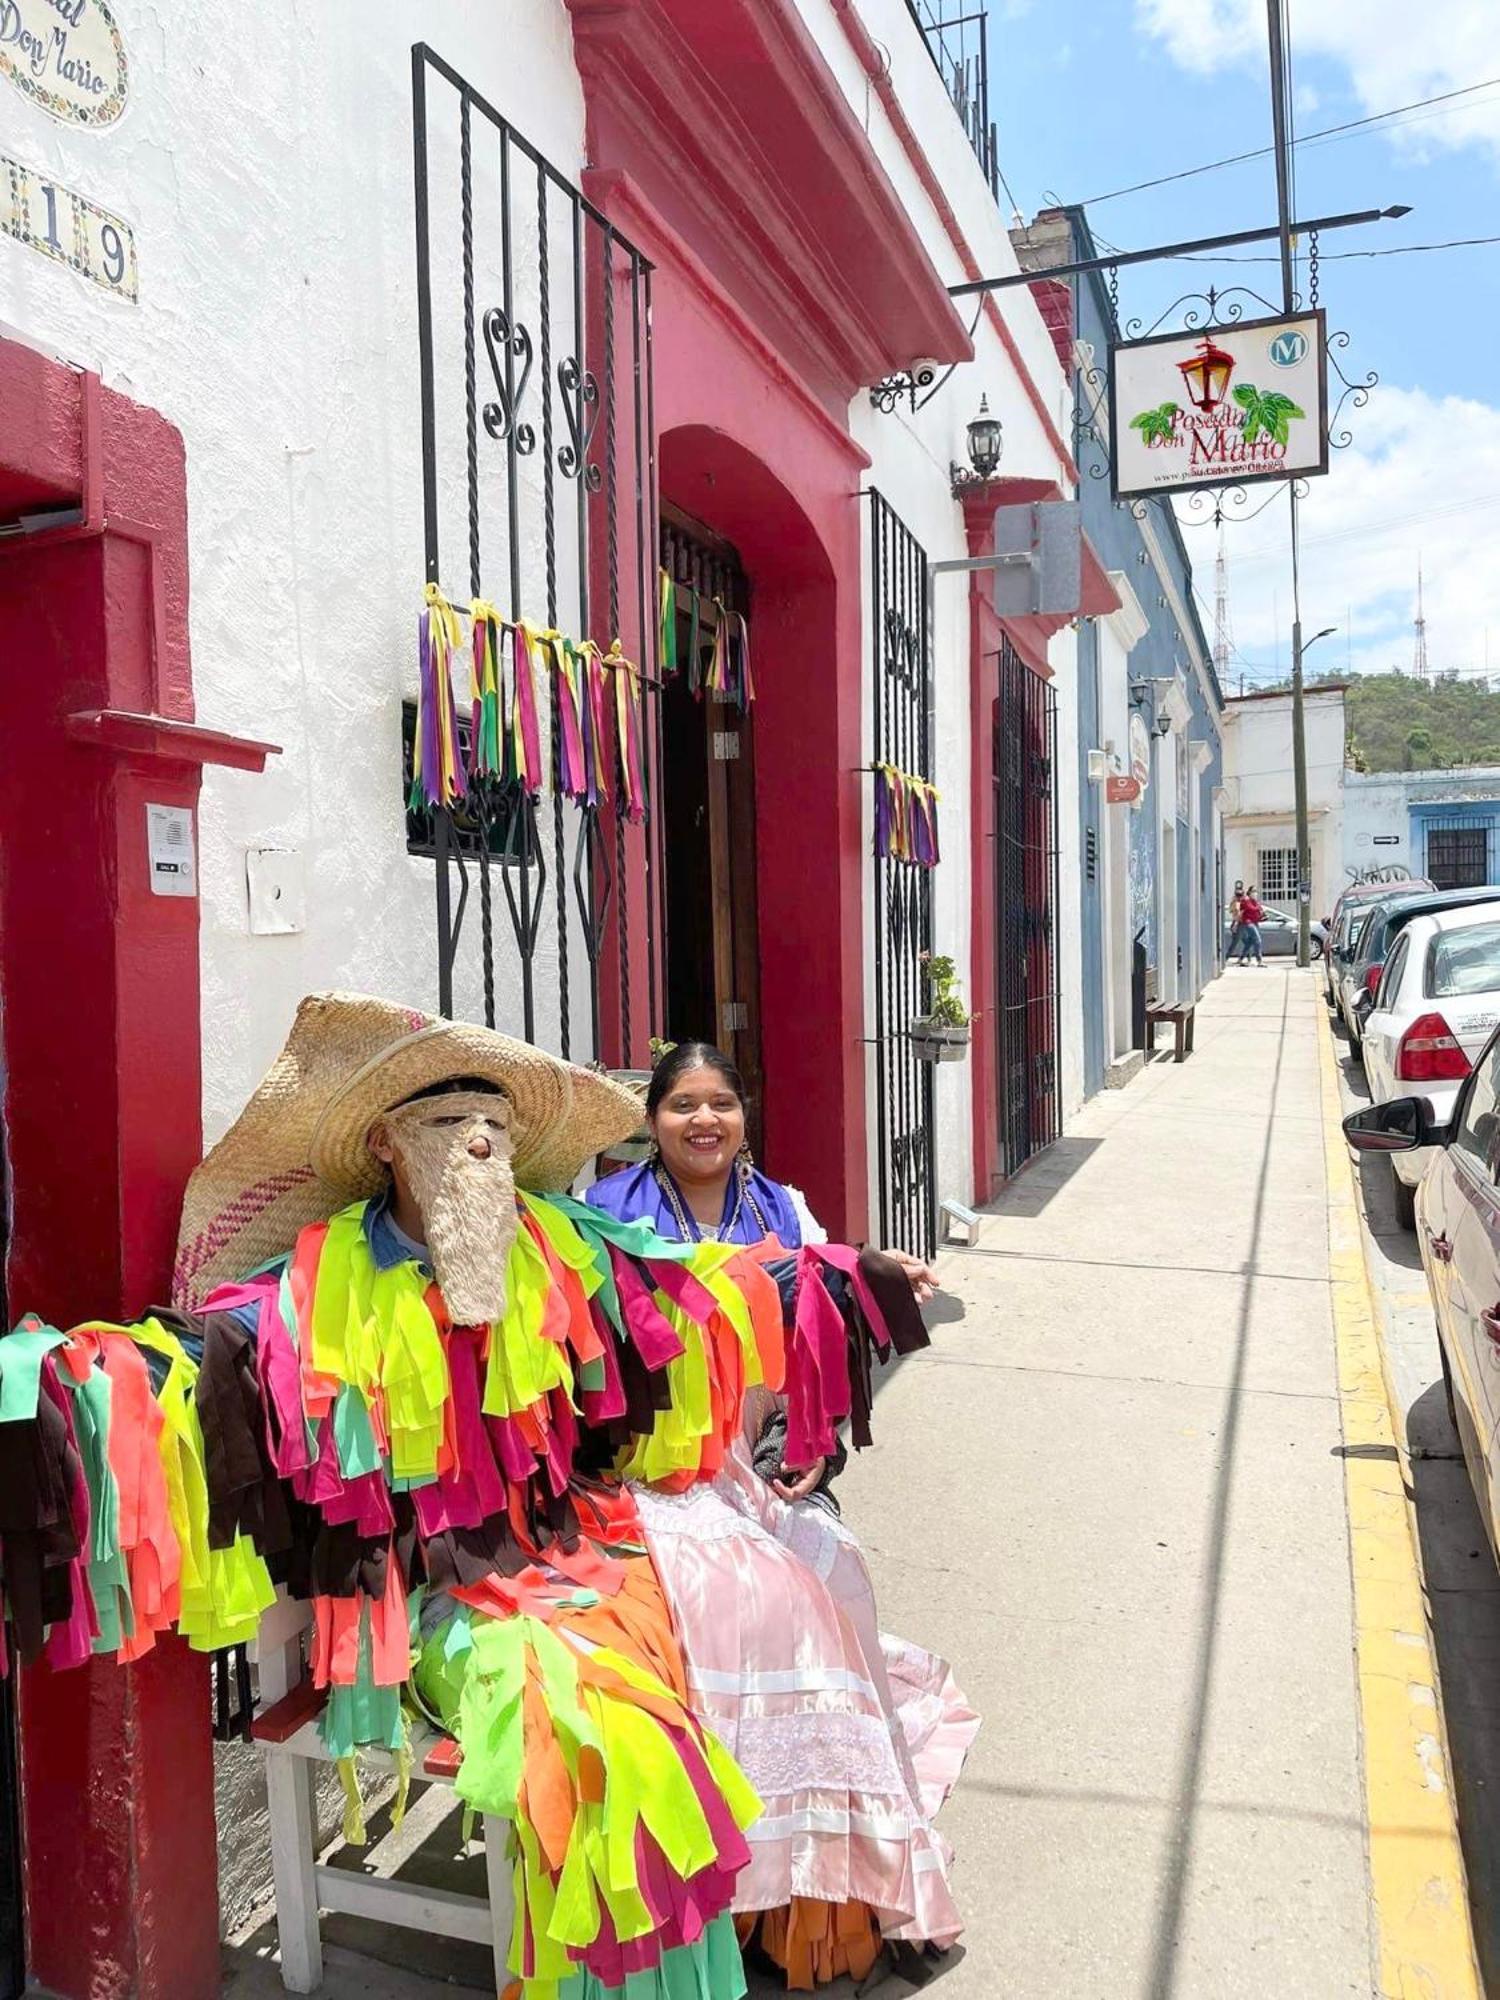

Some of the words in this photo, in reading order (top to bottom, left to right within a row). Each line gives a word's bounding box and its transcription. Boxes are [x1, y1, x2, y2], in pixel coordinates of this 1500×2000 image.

[0, 0, 45, 61] Don
[31, 26, 109, 95] Mario
[1275, 336, 1300, 362] M
[1148, 431, 1185, 448] Don
[1189, 428, 1287, 464] Mario
